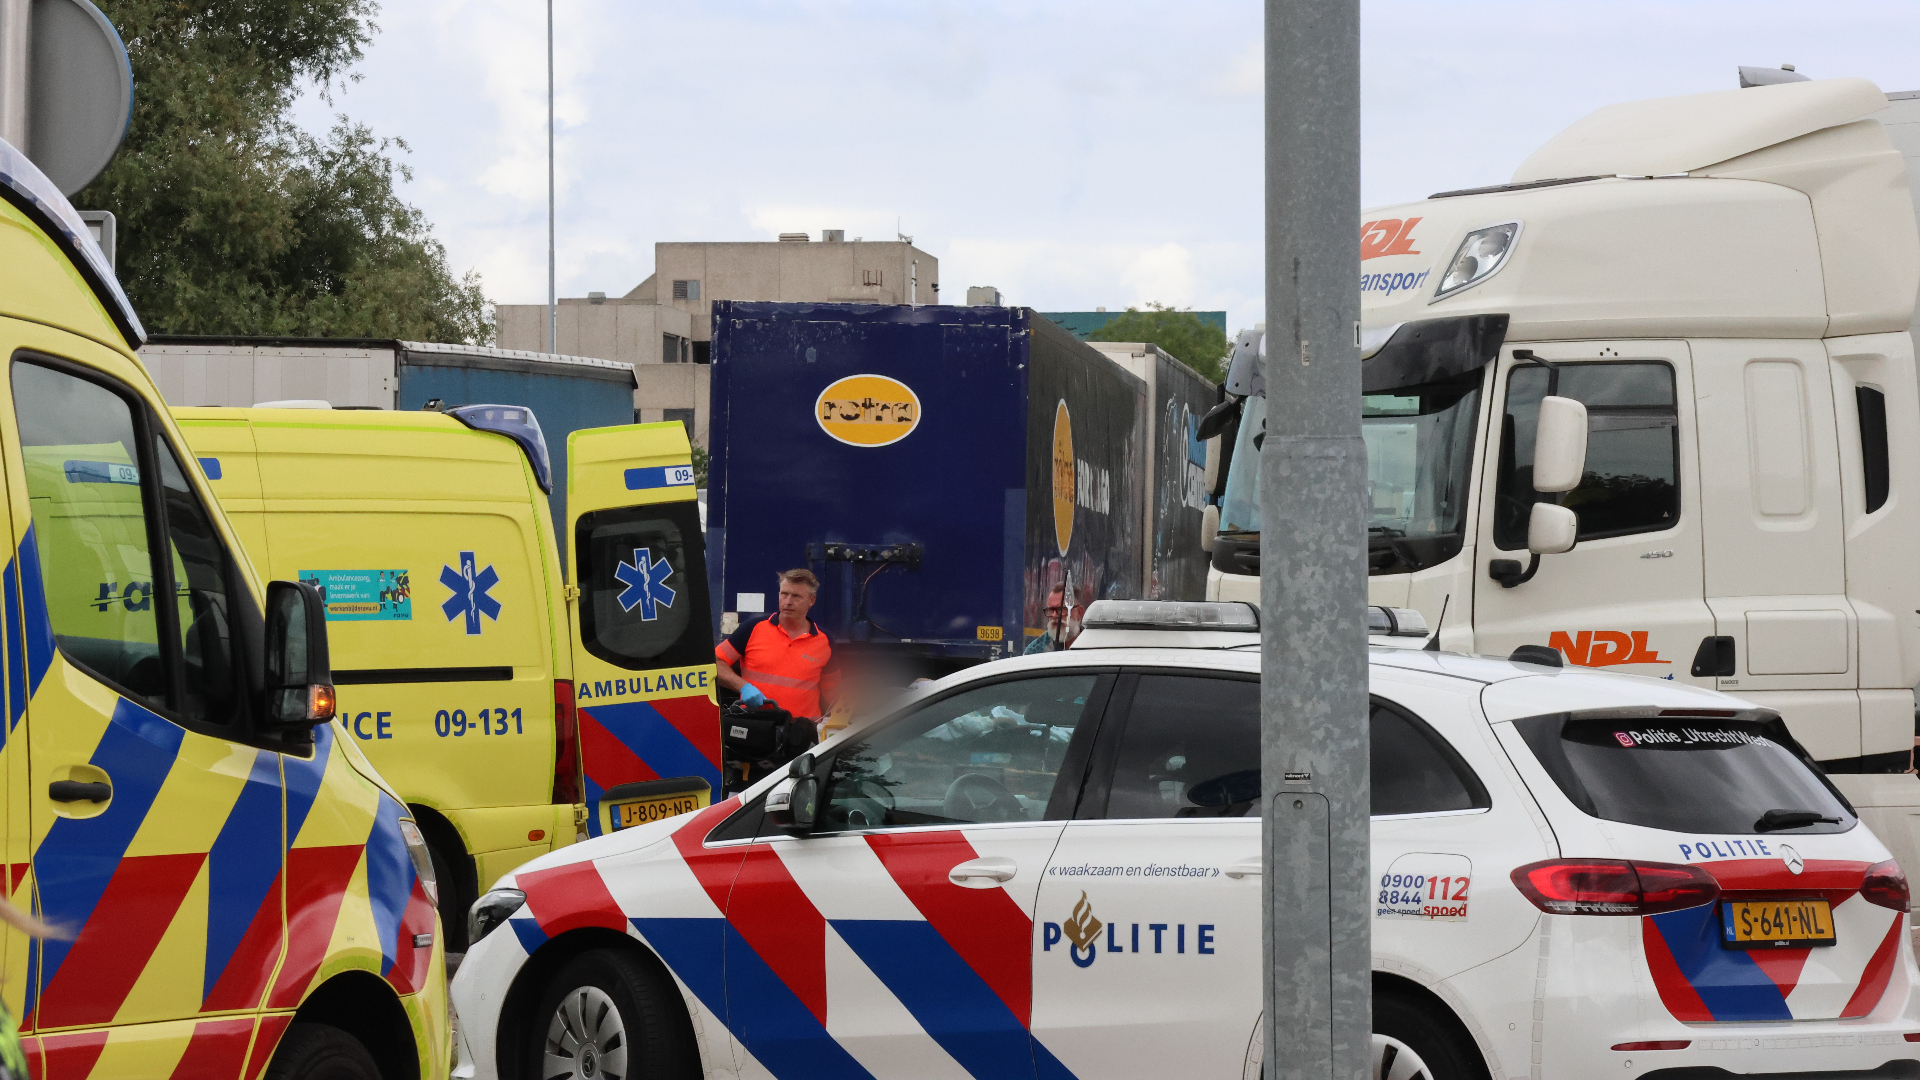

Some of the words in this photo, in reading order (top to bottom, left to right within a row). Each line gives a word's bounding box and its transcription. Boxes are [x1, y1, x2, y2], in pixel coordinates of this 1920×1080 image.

[1361, 267, 1431, 296] ansport
[1640, 550, 1673, 559] 450
[980, 628, 1000, 639] 9698
[1548, 630, 1673, 668] NDL
[578, 671, 708, 699] AMBULANCE
[434, 707, 523, 737] 09-131
[1678, 839, 1772, 860] POLITIE
[1059, 863, 1124, 876] waakzaam
[1125, 866, 1142, 876] en
[1143, 863, 1211, 877] dienstbaar
[1381, 874, 1425, 888] 0900
[1427, 876, 1470, 901] 112
[1378, 890, 1422, 904] 8844
[1423, 903, 1467, 919] spoed
[1741, 906, 1825, 937] S-641-NL
[1726, 926, 1735, 935] NL
[1043, 921, 1216, 969] POLITIE
